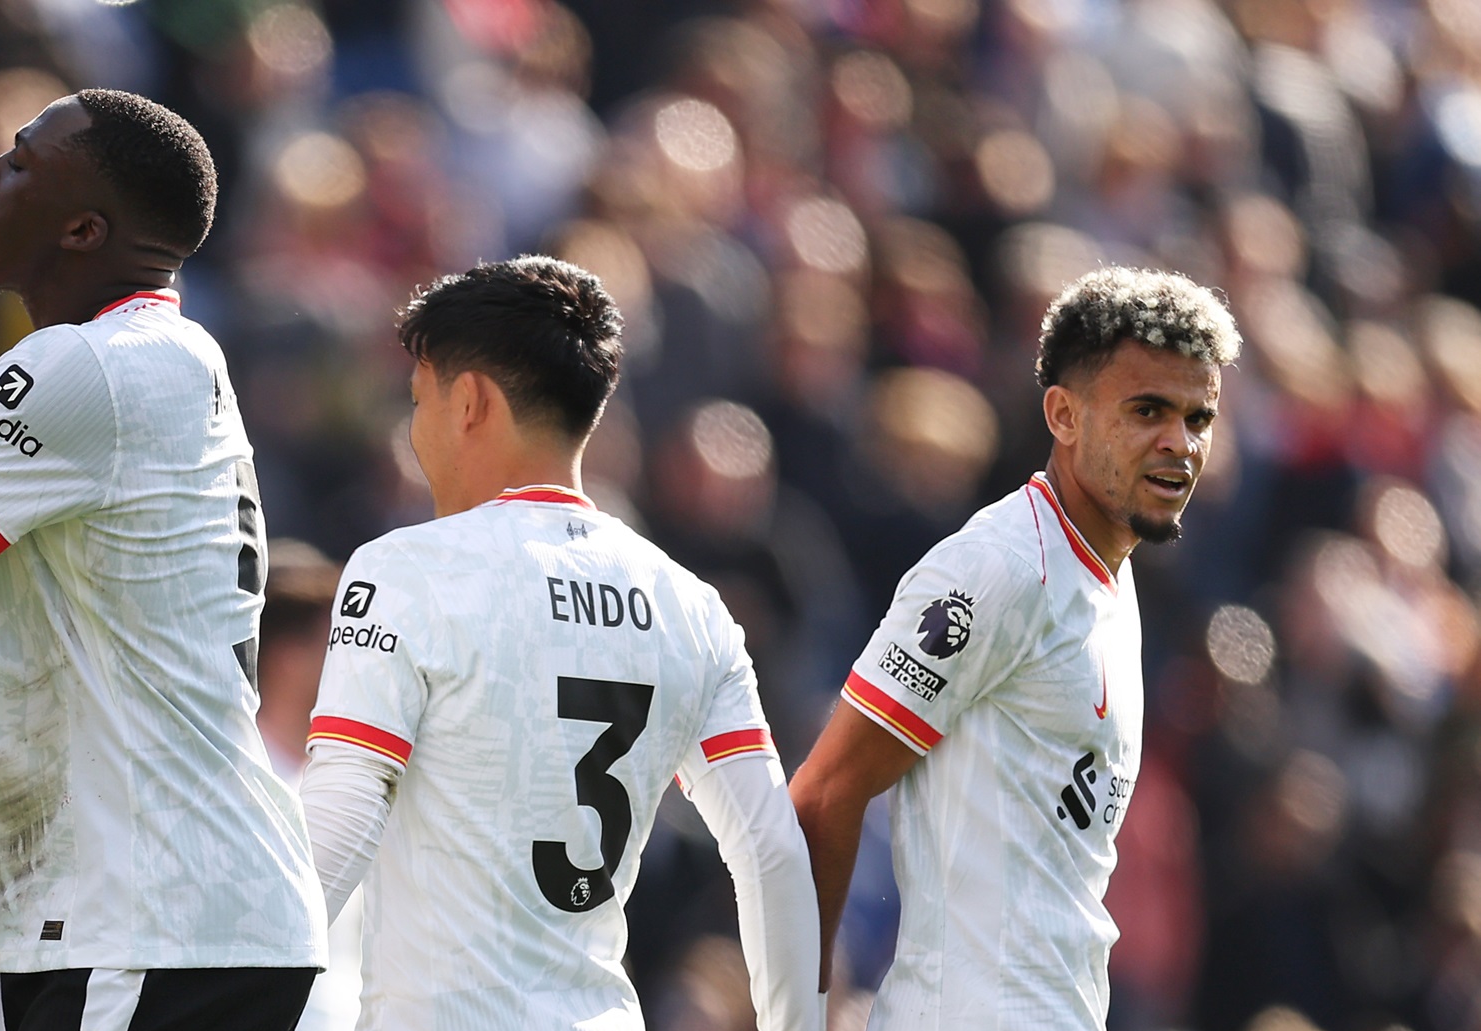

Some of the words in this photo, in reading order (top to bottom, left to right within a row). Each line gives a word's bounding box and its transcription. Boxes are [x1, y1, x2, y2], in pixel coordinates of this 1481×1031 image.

[547, 577, 652, 631] ENDO
[330, 624, 398, 653] pedia
[879, 654, 899, 674] for
[895, 669, 936, 702] racism
[885, 643, 905, 665] No
[903, 659, 939, 689] room
[532, 676, 655, 913] 3
